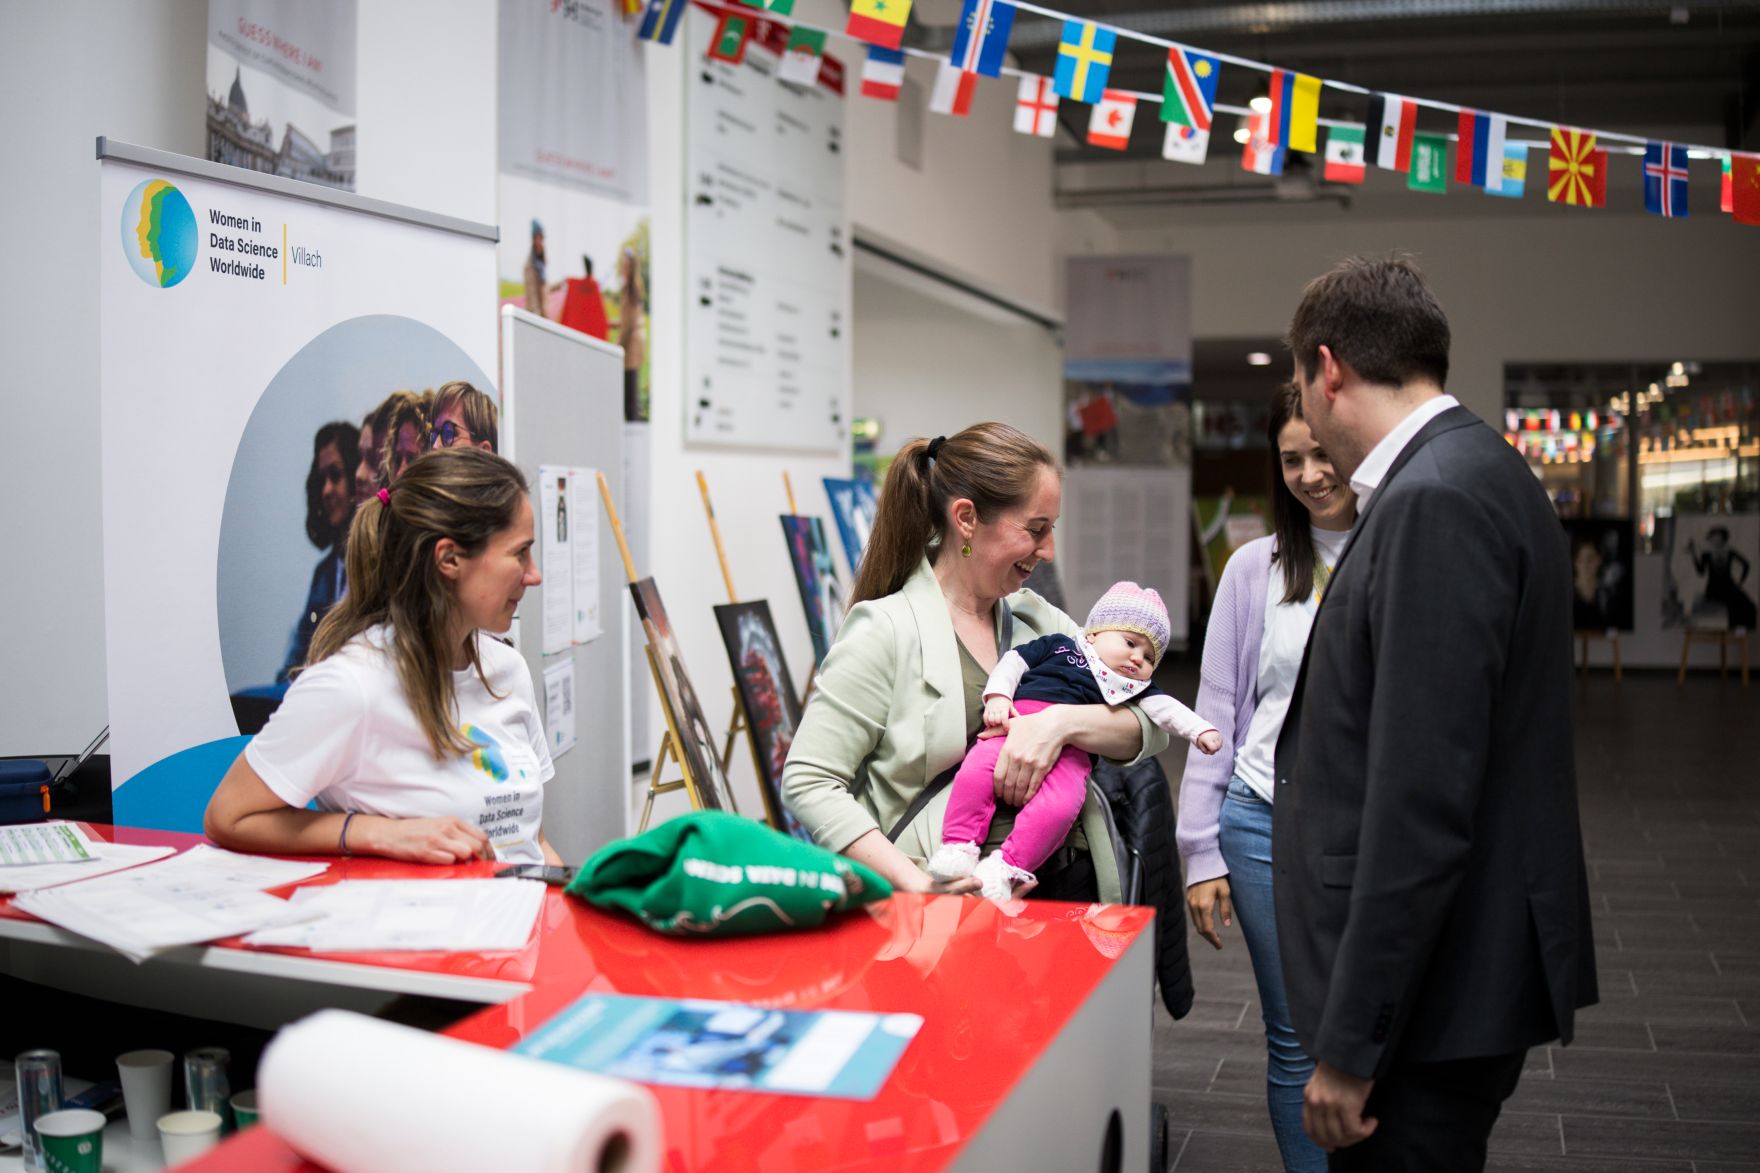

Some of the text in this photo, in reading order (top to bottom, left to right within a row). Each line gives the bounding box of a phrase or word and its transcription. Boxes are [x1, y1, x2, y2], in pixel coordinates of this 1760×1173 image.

[209, 209, 262, 233] Women in
[210, 233, 279, 259] Data Science
[292, 246, 322, 268] Villach
[210, 257, 265, 280] Worldwide
[484, 791, 521, 806] Women in
[479, 808, 524, 825] Data Science
